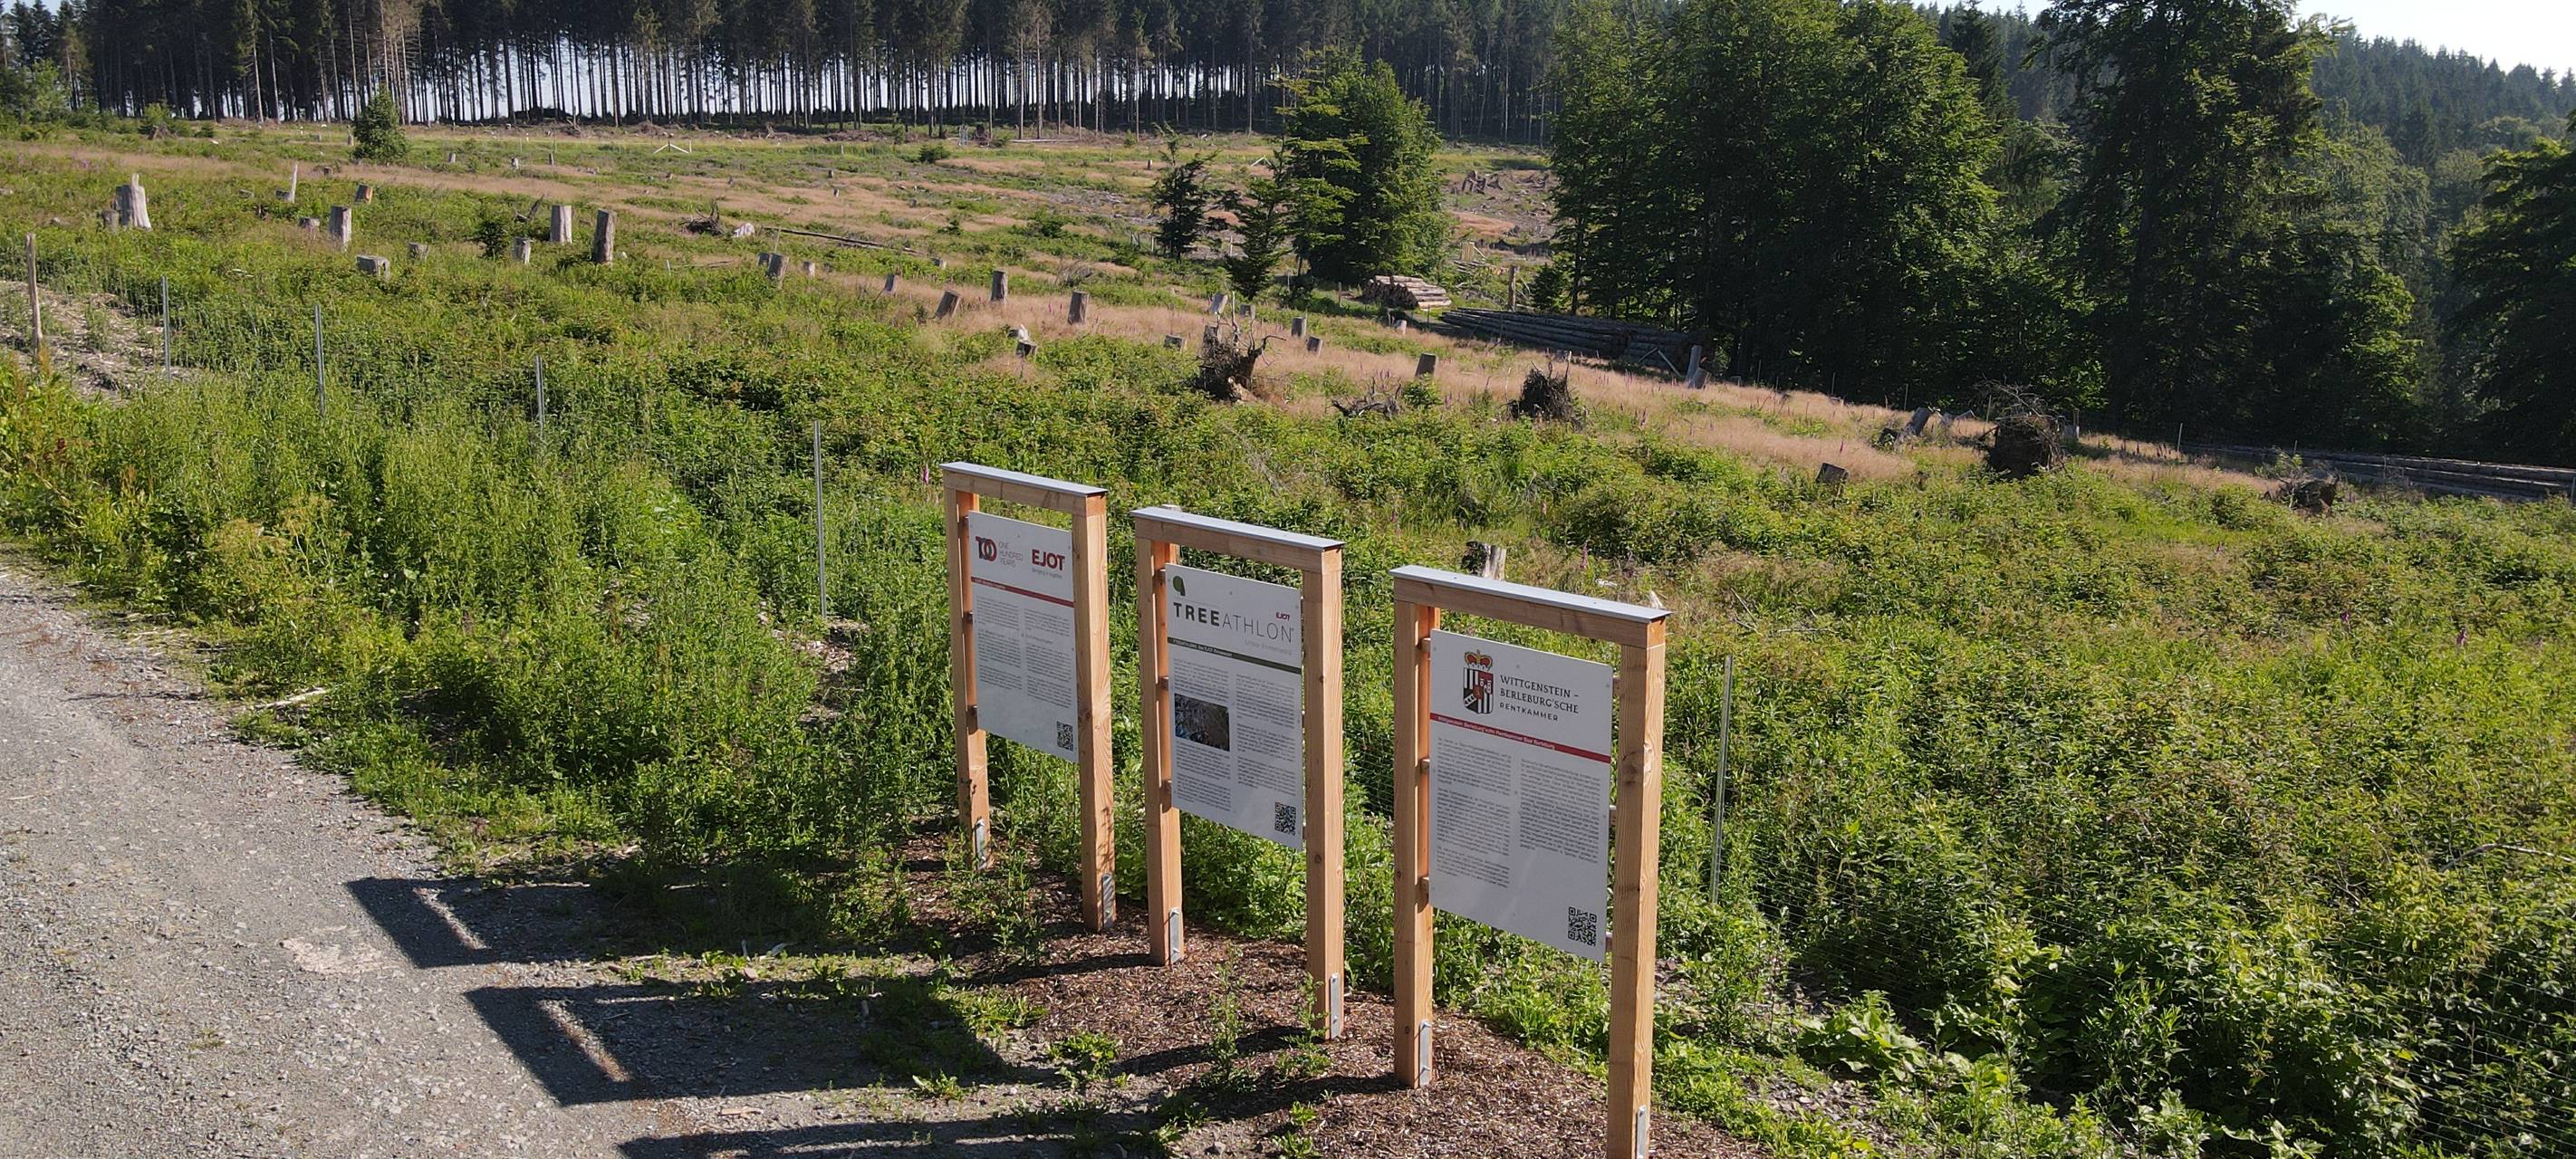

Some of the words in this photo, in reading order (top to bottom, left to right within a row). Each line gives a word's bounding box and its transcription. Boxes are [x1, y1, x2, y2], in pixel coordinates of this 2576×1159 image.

[1032, 549, 1065, 571] EJOT
[1275, 611, 1290, 621] EJOT
[1500, 675, 1571, 698] WITTGENSTEIN
[1500, 688, 1579, 714] BERLEBURG'SCHE
[1500, 703, 1558, 722] RENTKAMMER
